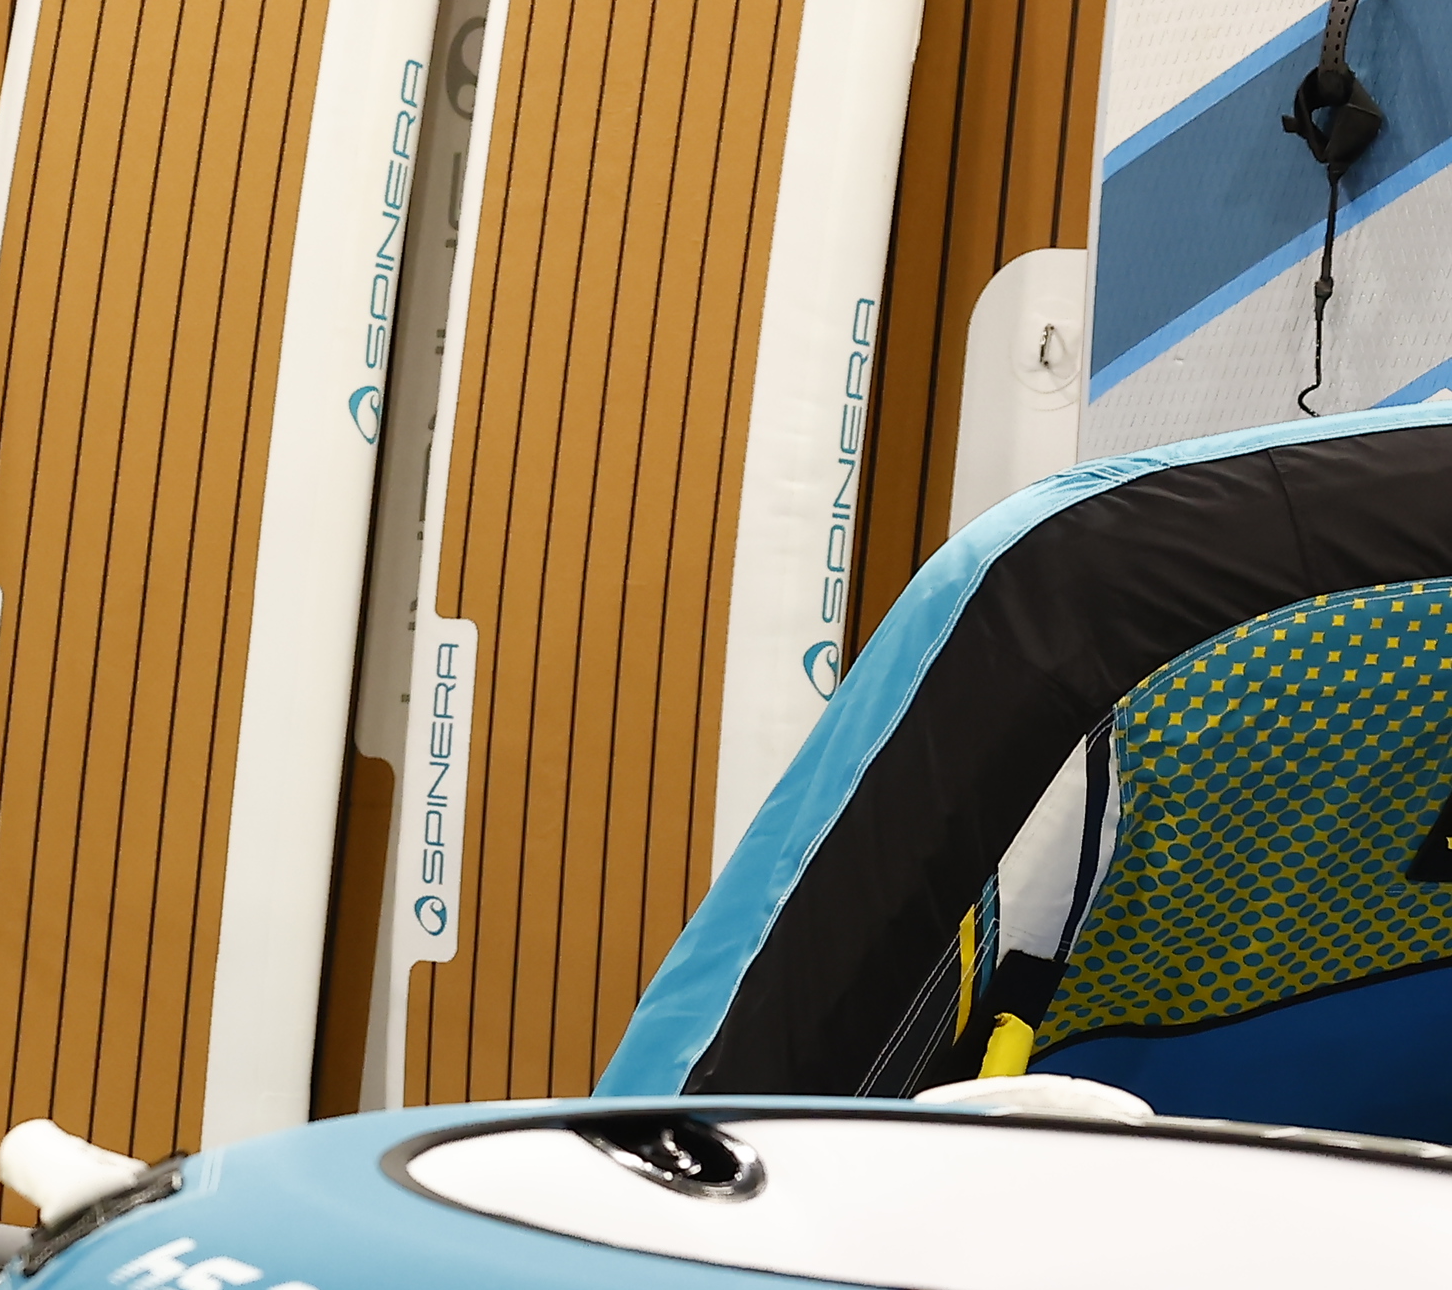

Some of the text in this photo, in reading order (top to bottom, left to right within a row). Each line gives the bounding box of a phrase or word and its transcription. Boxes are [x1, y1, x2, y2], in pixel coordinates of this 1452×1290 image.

[363, 58, 423, 370] SPINERA
[821, 297, 876, 624] SPINERA
[420, 641, 460, 885] SPINERA
